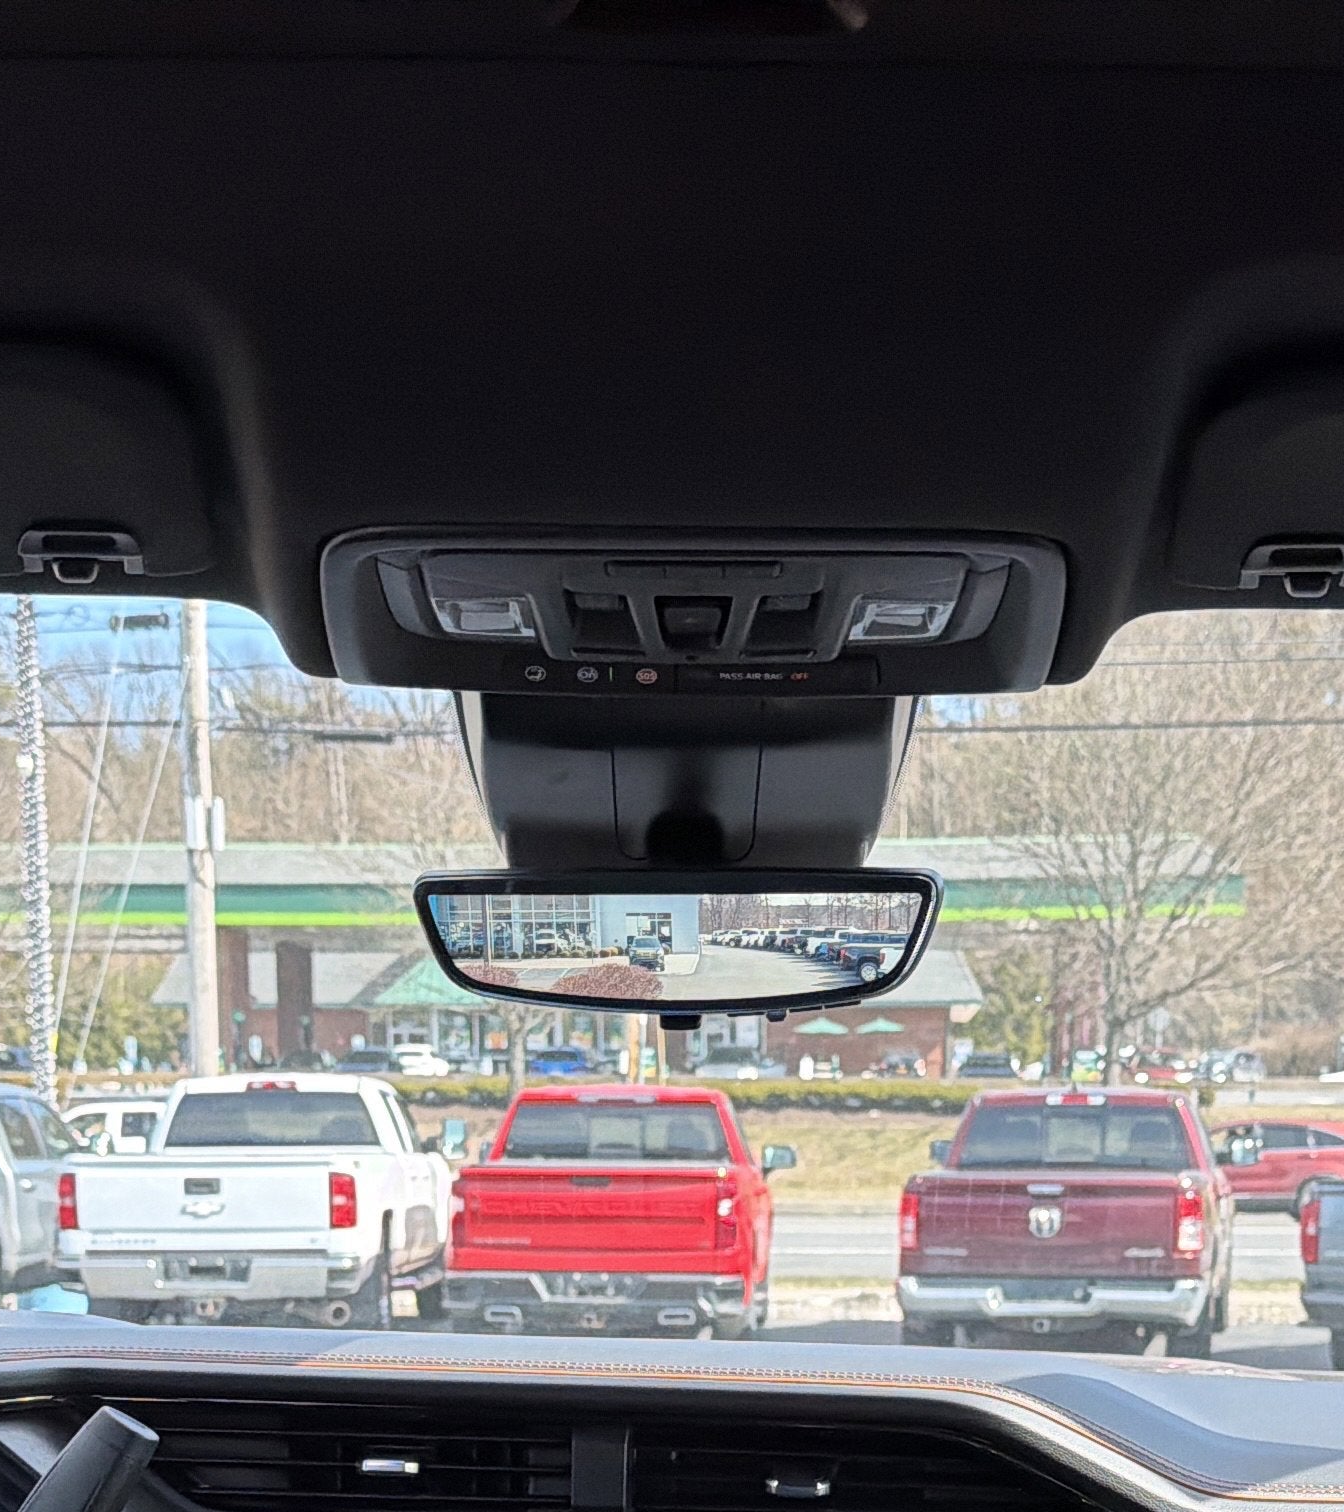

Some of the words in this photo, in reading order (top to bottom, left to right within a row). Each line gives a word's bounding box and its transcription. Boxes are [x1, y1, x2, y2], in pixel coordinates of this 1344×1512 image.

[719, 672, 743, 680] PASS
[745, 672, 761, 680] AIR
[764, 672, 783, 680] BAG
[790, 672, 809, 681] OFF
